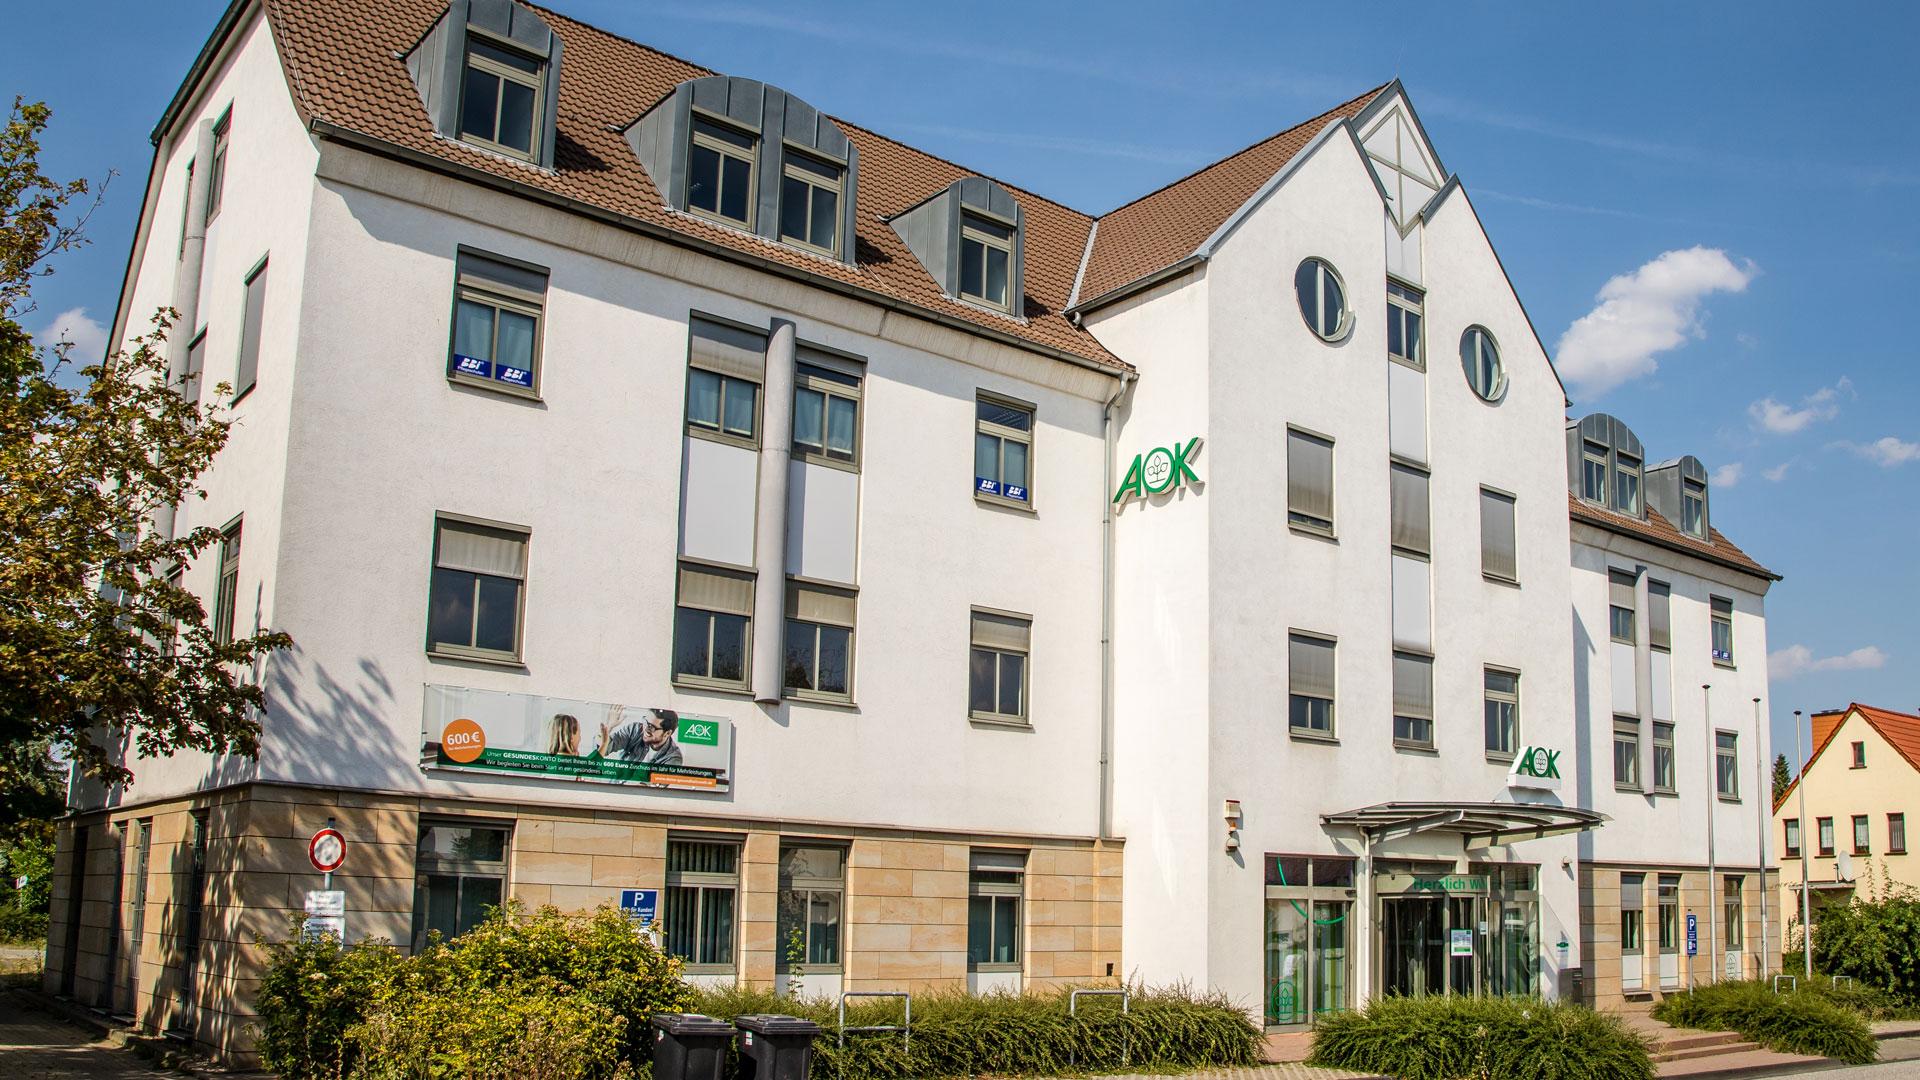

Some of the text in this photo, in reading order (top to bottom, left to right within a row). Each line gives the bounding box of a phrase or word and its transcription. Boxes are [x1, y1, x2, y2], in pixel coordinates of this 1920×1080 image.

[1112, 436, 1200, 504] AOK
[684, 724, 712, 737] AOK
[447, 731, 480, 745] 600 €
[503, 752, 557, 762] GESUNDESKONTO
[1516, 746, 1561, 779] AOK
[1413, 877, 1466, 889] Herzlich
[634, 892, 645, 907] P
